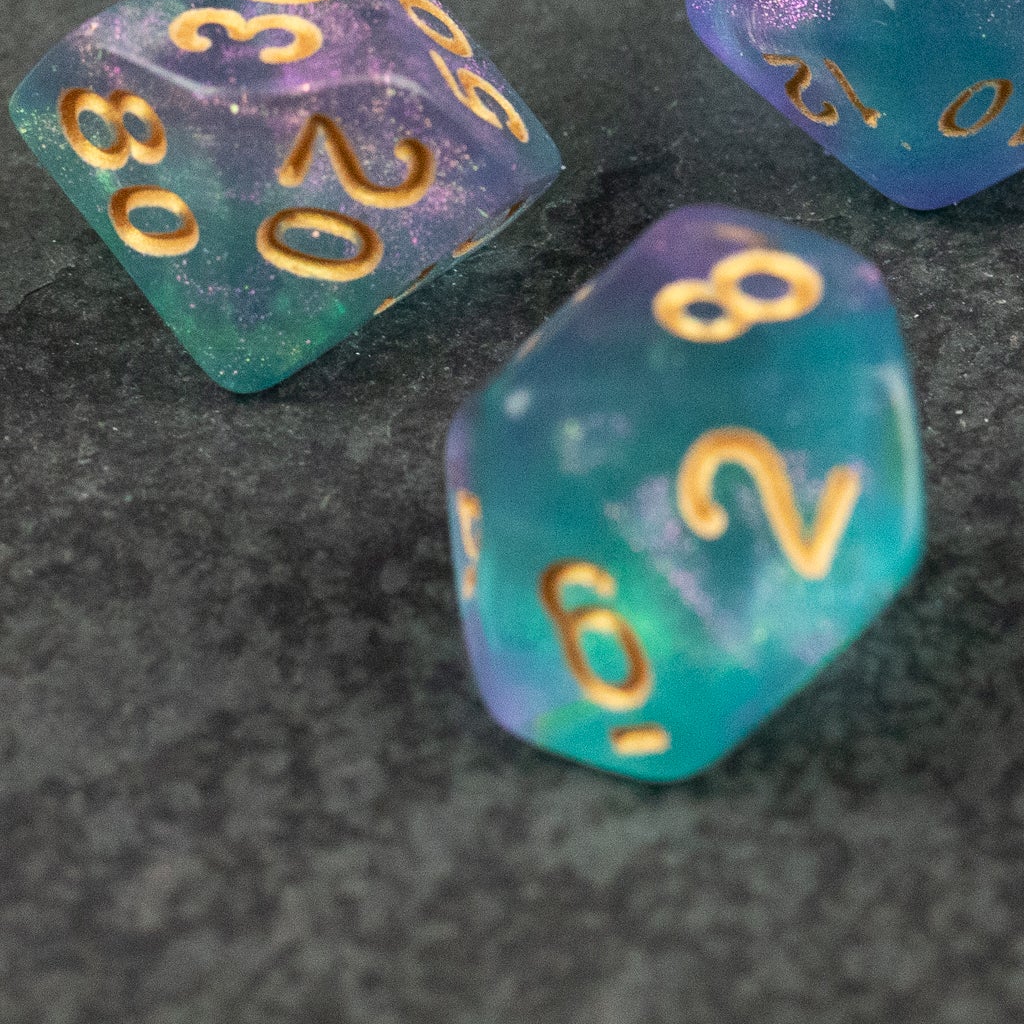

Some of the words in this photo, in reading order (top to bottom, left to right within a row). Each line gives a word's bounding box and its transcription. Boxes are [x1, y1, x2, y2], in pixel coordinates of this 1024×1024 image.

[763, 53, 881, 128] 12
[59, 87, 199, 256] 80
[256, 114, 437, 282] 20
[652, 248, 824, 343] 8
[677, 426, 862, 578] 2
